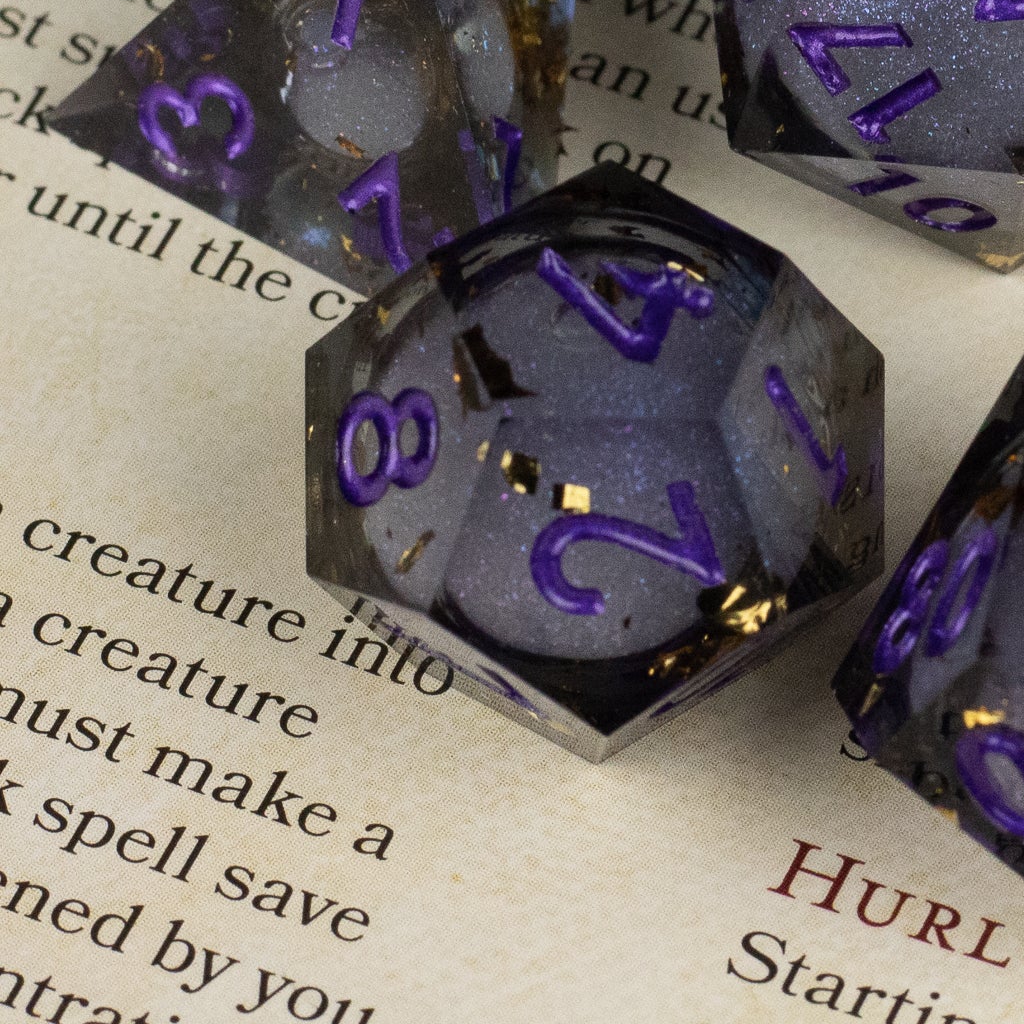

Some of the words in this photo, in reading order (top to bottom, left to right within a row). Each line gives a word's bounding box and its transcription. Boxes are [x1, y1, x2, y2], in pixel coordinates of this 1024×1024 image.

[26, 185, 184, 262] until
[190, 236, 293, 303] the
[336, 386, 440, 509] 8
[21, 516, 309, 645] creature
[318, 612, 456, 697] into
[31, 609, 321, 740] creature
[141, 743, 340, 839] make
[351, 819, 398, 864] a
[31, 794, 211, 884] spell
[213, 863, 373, 943] save
[765, 836, 1013, 969] HURL
[0, 869, 146, 956] ned
[149, 917, 242, 995] by
[725, 928, 980, 1024] Starti
